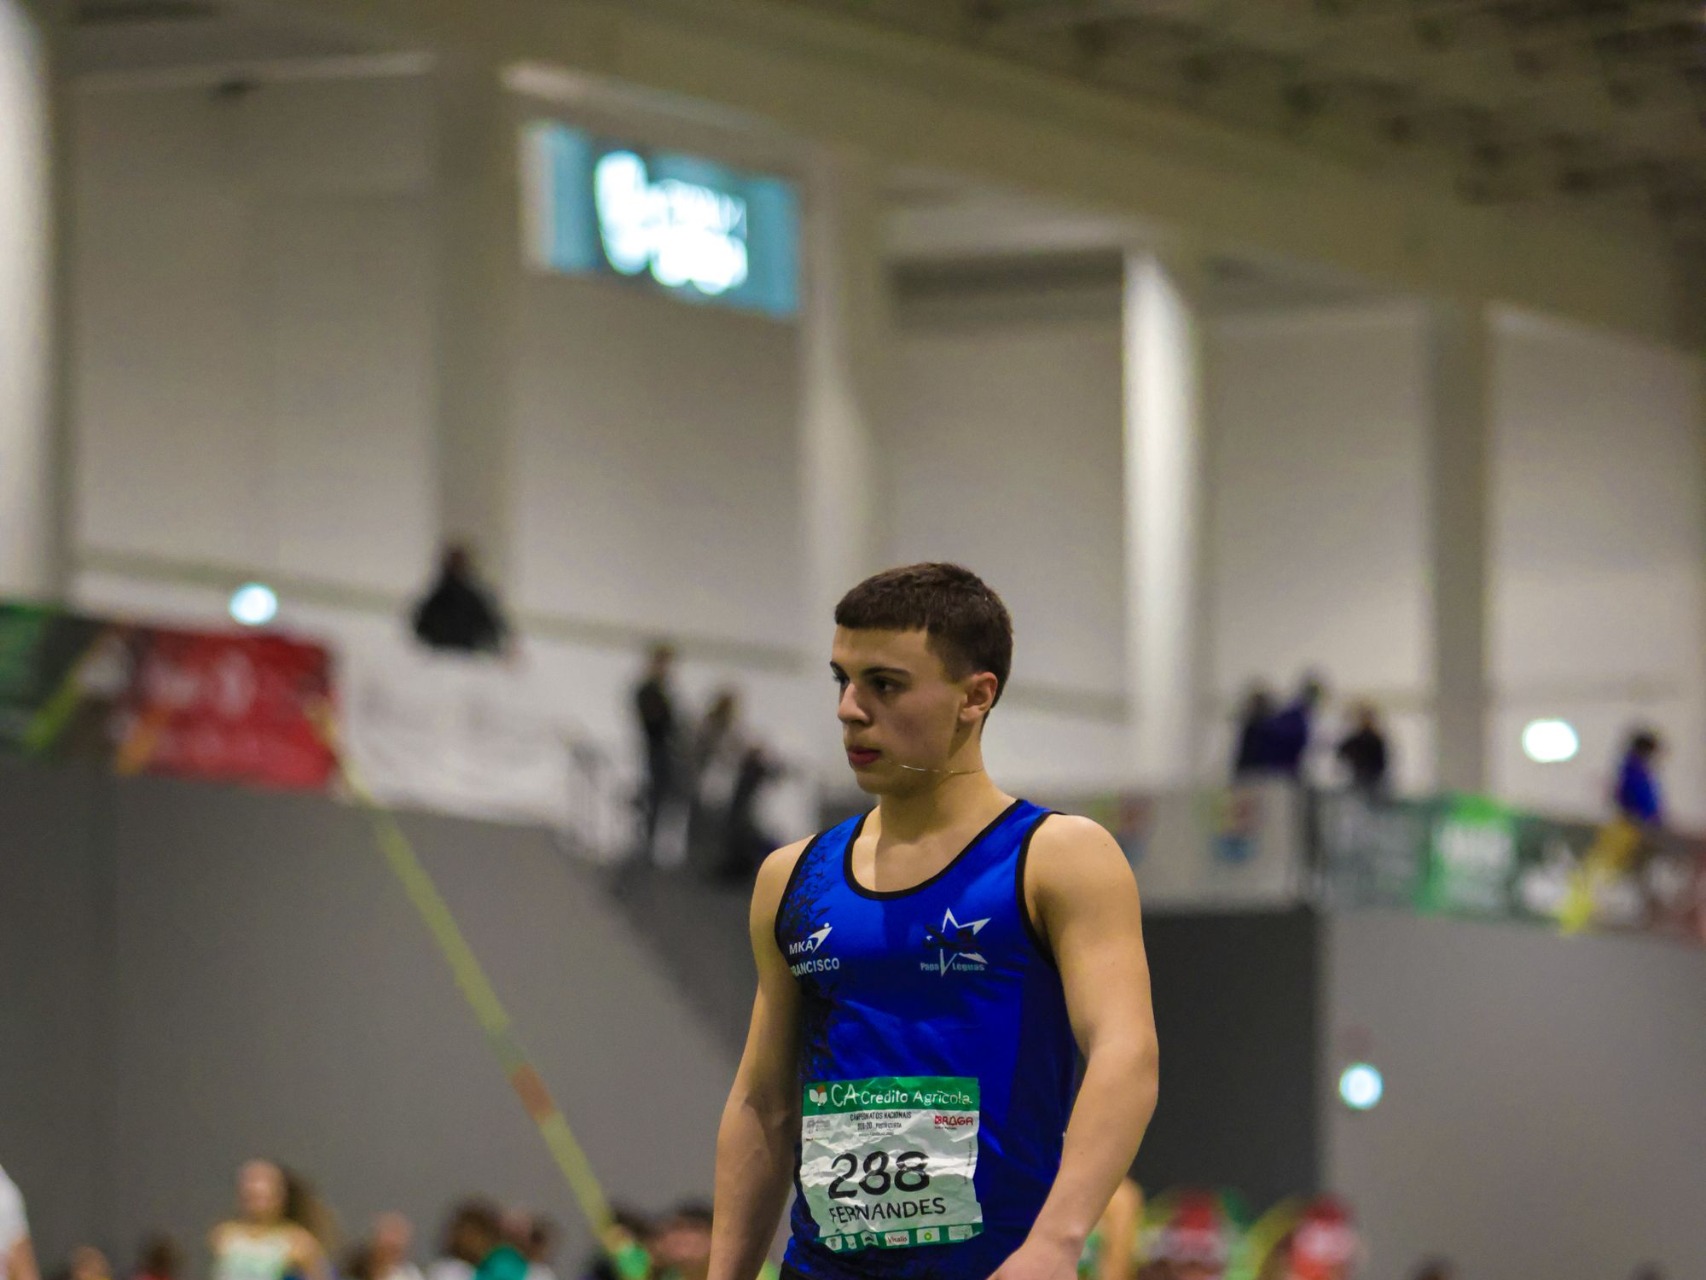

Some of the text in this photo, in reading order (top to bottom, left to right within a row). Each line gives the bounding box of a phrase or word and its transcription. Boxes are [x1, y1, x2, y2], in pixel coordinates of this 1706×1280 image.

[789, 940, 814, 955] MKA
[790, 957, 840, 977] RANCISCO
[831, 1083, 860, 1107] CA
[860, 1089, 908, 1104] Crédito
[884, 1111, 912, 1120] NACIONAIS
[934, 1115, 974, 1126] BRAGA
[828, 1150, 930, 1199] 288
[829, 1197, 946, 1224] FERNANDES
